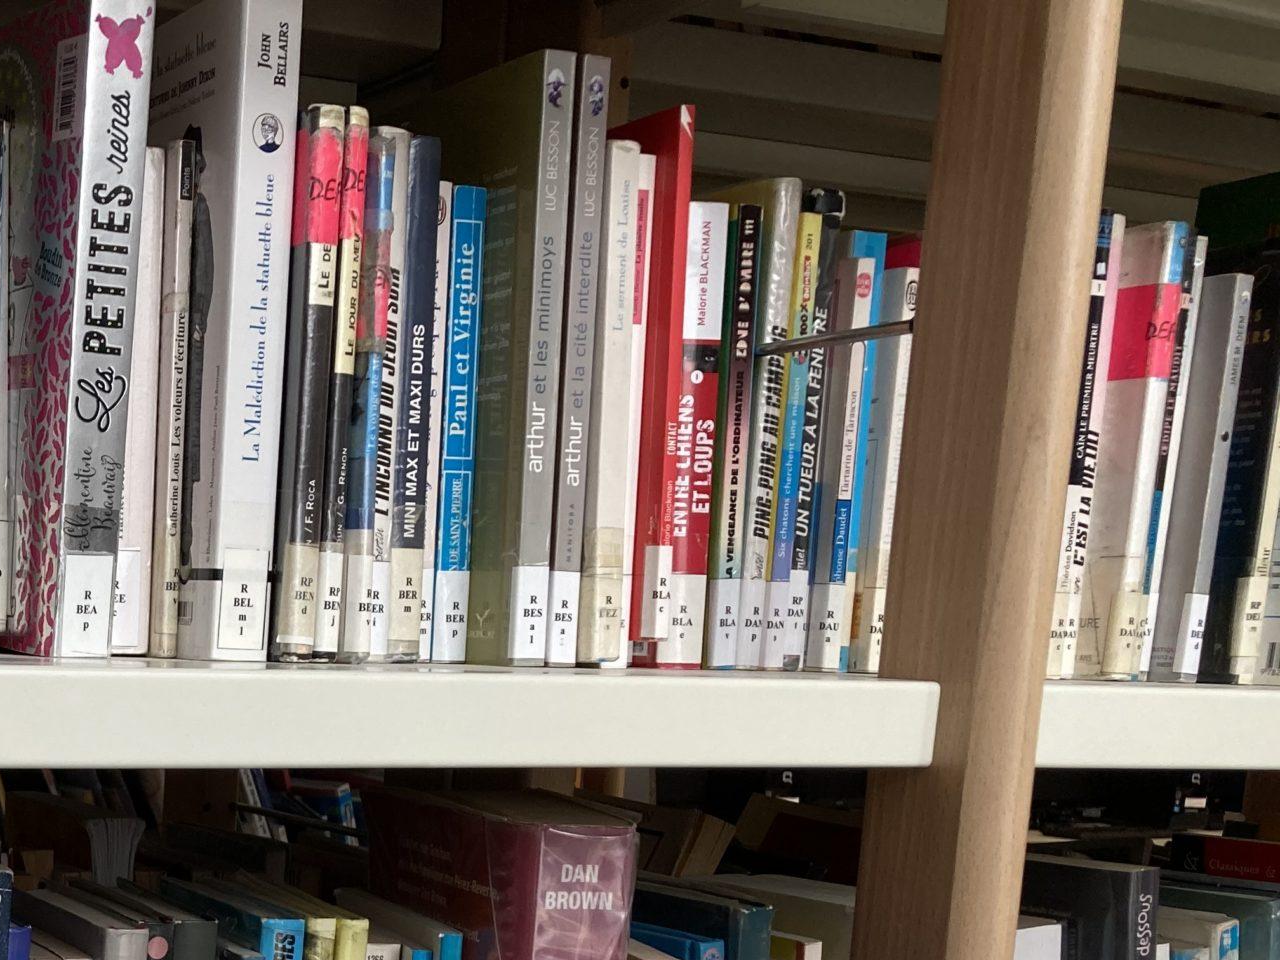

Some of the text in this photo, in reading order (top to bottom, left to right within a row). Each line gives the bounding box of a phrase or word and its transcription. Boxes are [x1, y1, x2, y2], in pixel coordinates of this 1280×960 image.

[258, 33, 273, 69] JOHN
[274, 22, 289, 87] BELLAIRS
[106, 90, 131, 174] reines
[83, 183, 133, 355] PETITES
[697, 220, 712, 326] Malorie BLACKMAN
[449, 243, 477, 436] Paul et Virginie
[527, 236, 553, 473] arthur et les minimoys
[404, 324, 425, 538] MINI MAX ET MAXI DURS
[692, 489, 710, 514] ET
[76, 605, 97, 615] BEA
[545, 892, 613, 911] BROWN
[561, 865, 598, 883] DAN
[1139, 893, 1153, 953] dessous
